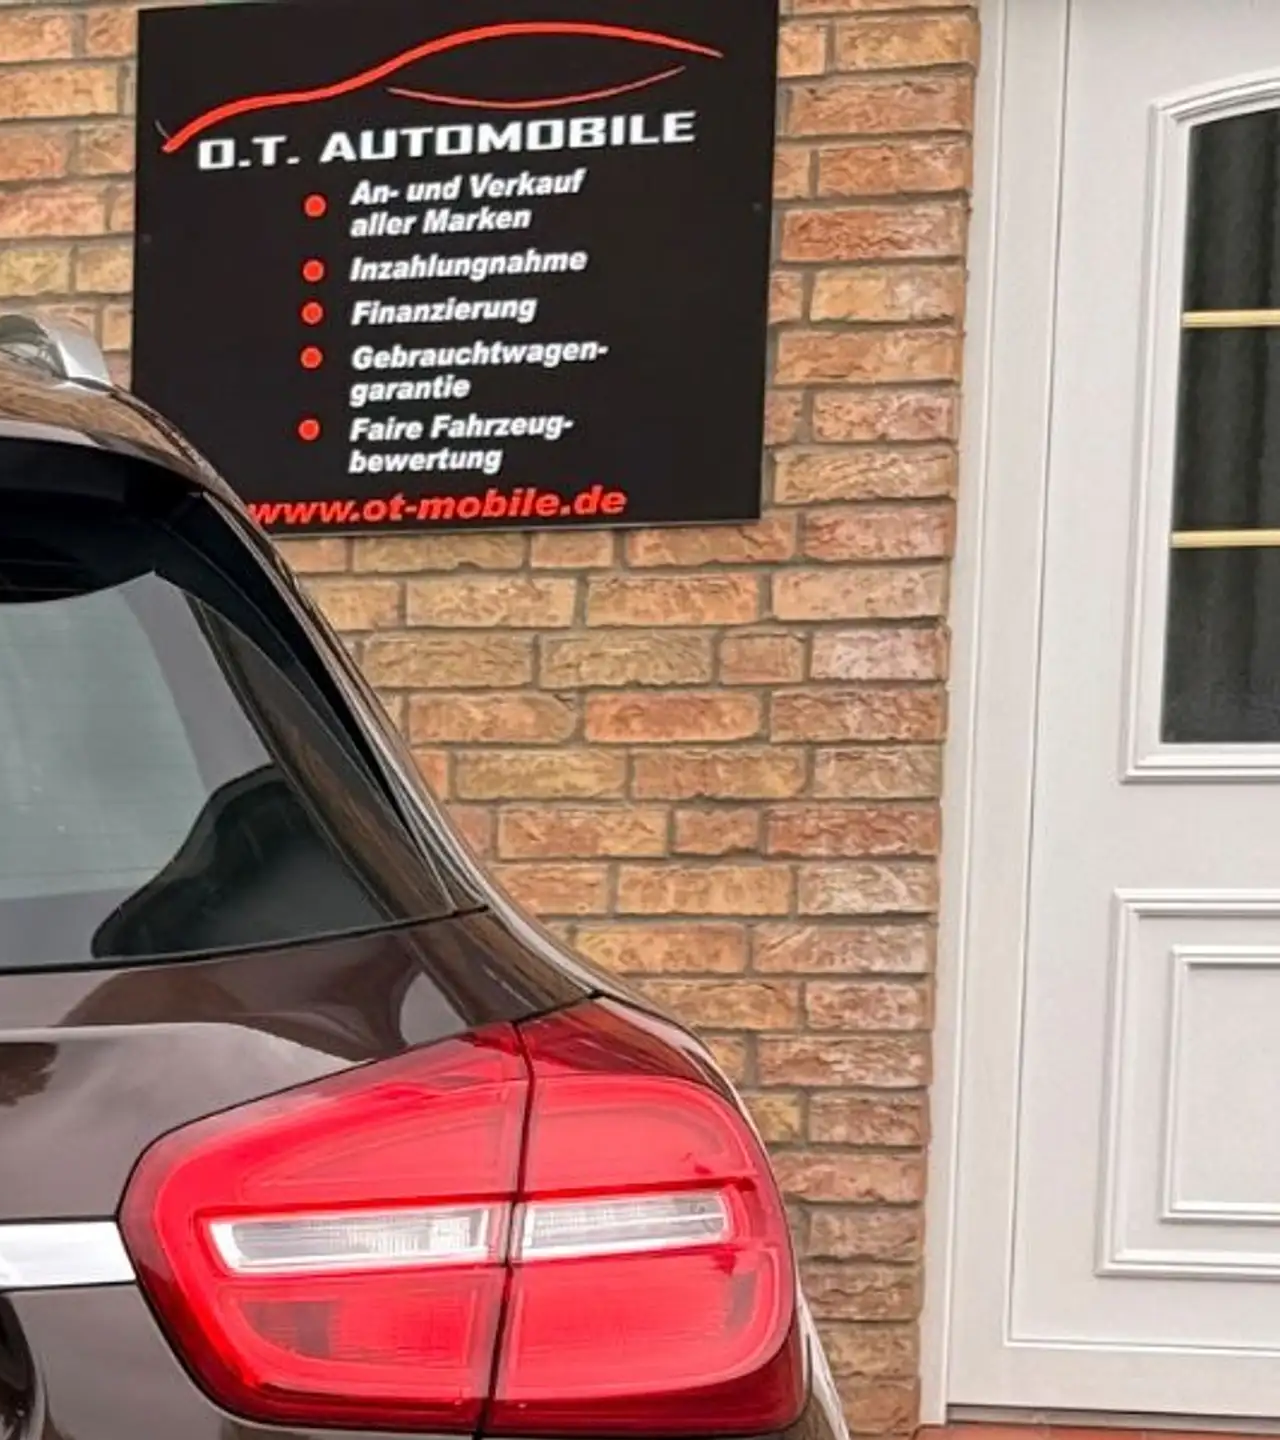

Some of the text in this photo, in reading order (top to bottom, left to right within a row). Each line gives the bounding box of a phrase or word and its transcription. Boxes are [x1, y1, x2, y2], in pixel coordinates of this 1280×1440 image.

[198, 111, 697, 170] O.T. AUTOMOBILE
[350, 168, 587, 206] An- und Verkauf
[350, 208, 532, 238] aller Marken
[349, 248, 589, 282] Inzahlungnahme
[351, 297, 538, 326] Finanzierung
[351, 339, 610, 370] Gebrauchtwagen-
[349, 374, 471, 408] garantie
[349, 413, 574, 441] Faire Fahrzeug-
[348, 448, 503, 475] bewertung
[247, 484, 628, 525] www.ot-mobile.de
